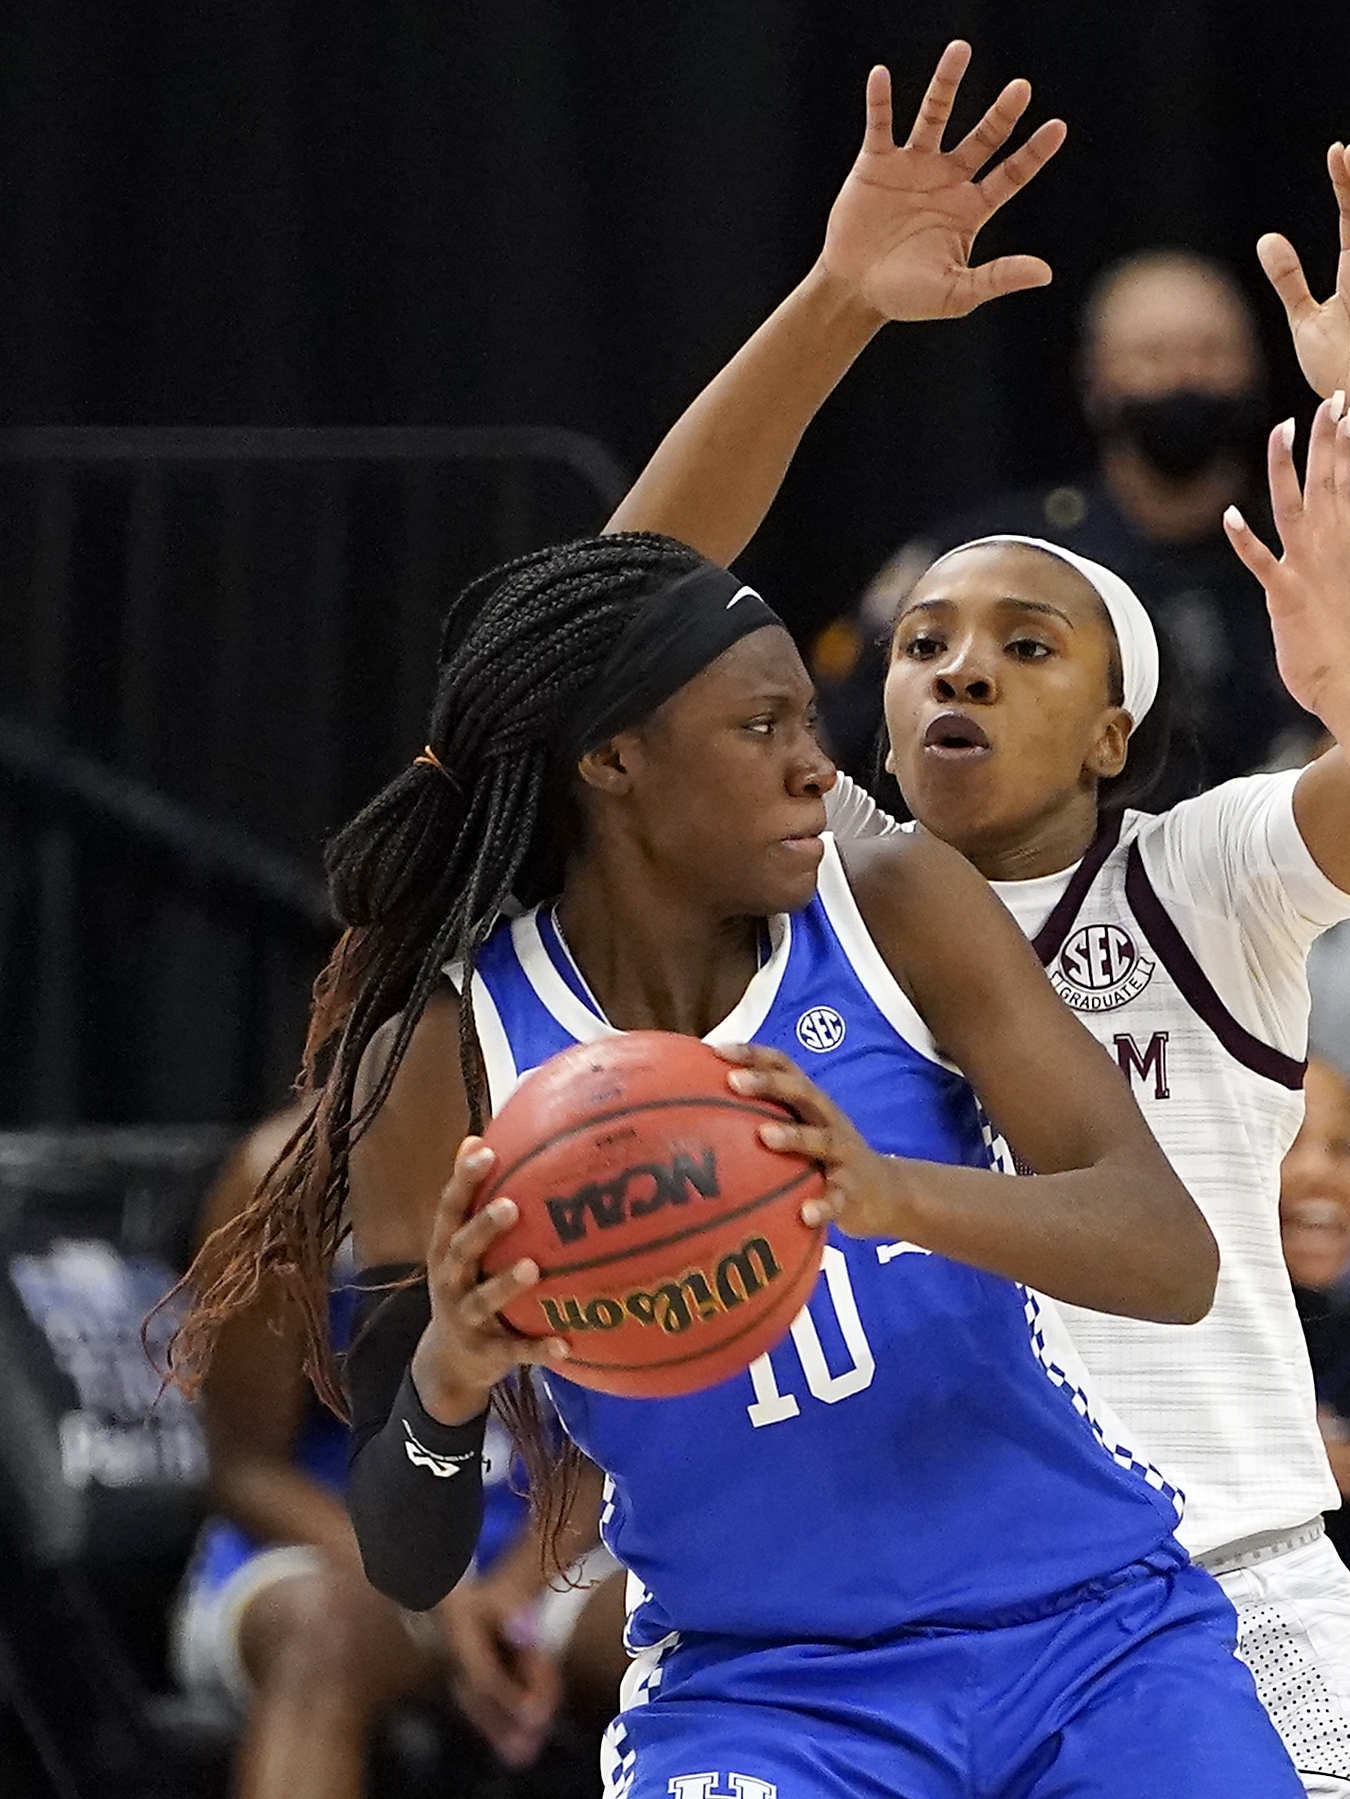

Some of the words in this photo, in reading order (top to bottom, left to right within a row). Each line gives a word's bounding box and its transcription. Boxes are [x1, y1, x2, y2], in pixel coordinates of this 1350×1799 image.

[1063, 926, 1133, 989] SEC
[1059, 977, 1142, 1011] GRADUATE
[799, 1009, 843, 1049] SEC
[545, 1147, 721, 1245] NCAA
[539, 1235, 784, 1336] Wilson
